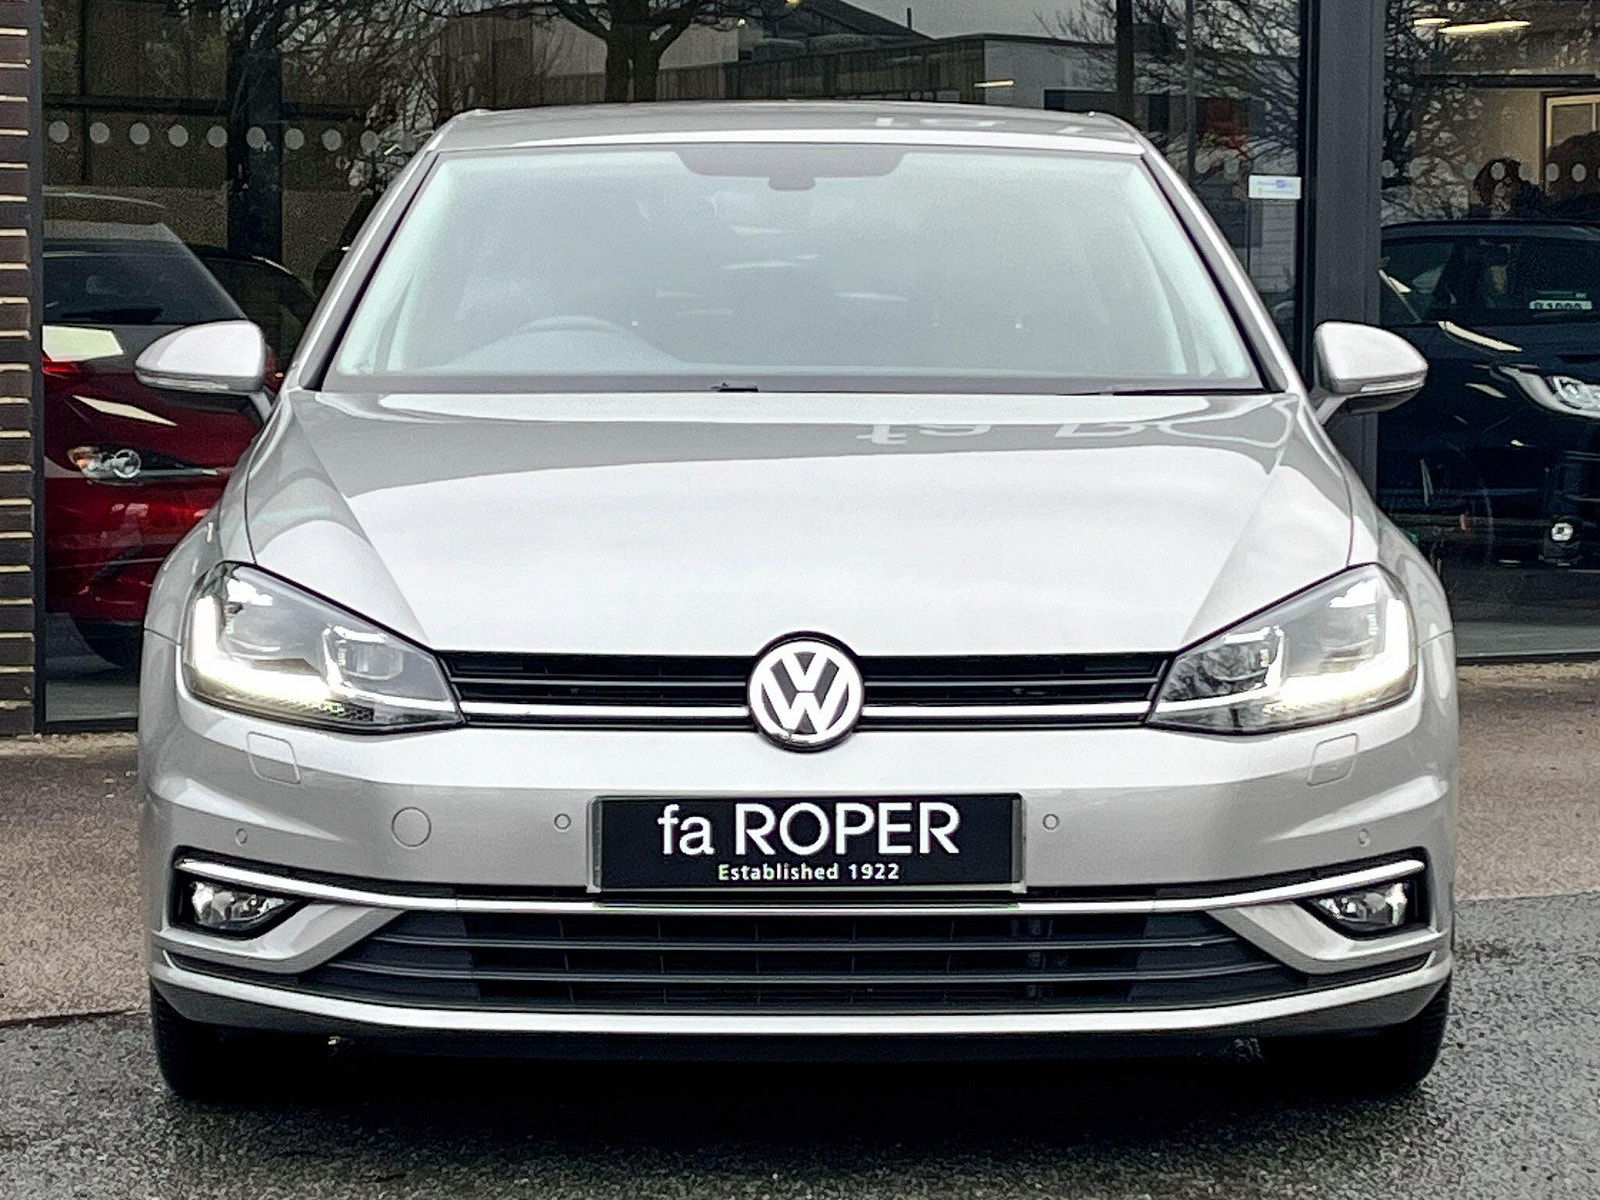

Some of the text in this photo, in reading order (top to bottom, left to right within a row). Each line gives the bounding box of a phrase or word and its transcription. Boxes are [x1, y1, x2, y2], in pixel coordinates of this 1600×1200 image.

[657, 801, 961, 856] fa ROPER
[718, 862, 900, 881] Established 1922
